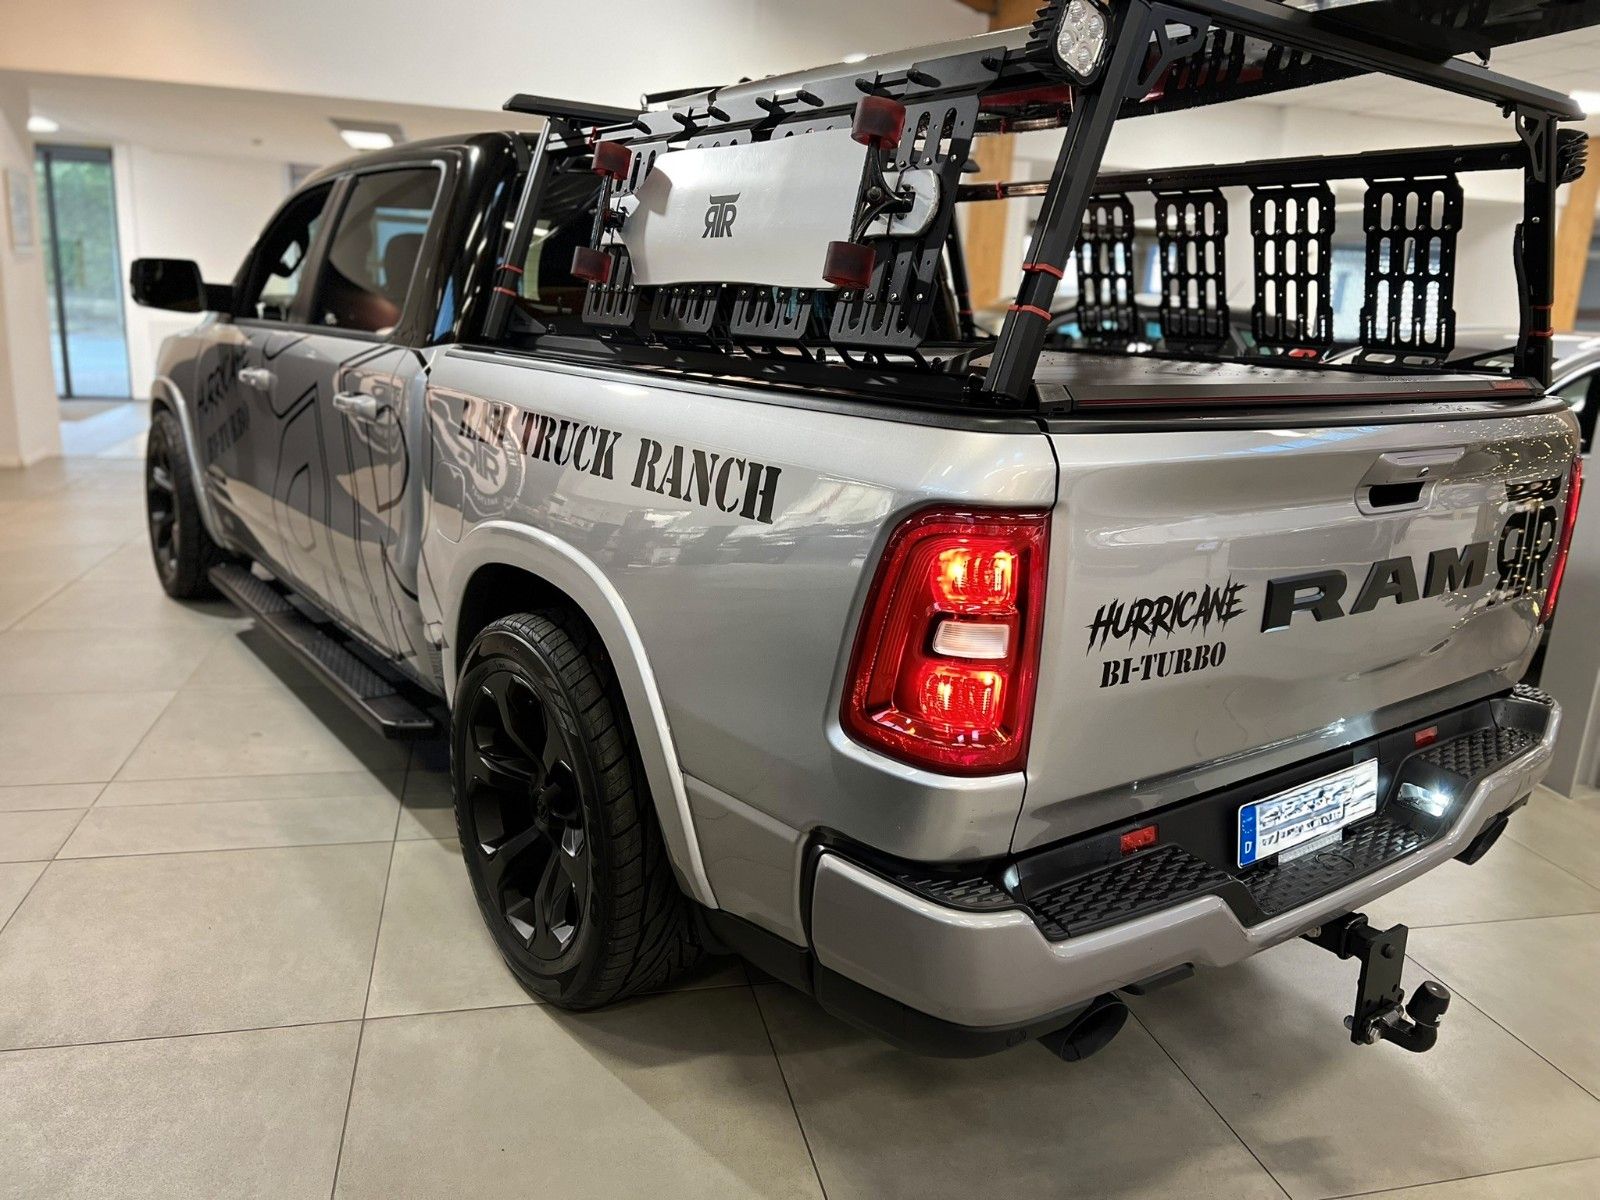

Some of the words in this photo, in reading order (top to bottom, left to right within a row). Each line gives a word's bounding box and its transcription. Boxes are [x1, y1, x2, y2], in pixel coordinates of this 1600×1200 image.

[521, 411, 623, 480] TRUCK
[631, 437, 782, 525] RANCH
[1085, 574, 1247, 657] HURRICANE
[1260, 541, 1490, 633] RAM
[1099, 641, 1227, 688] BI-TURBO
[1244, 841, 1253, 854] D
